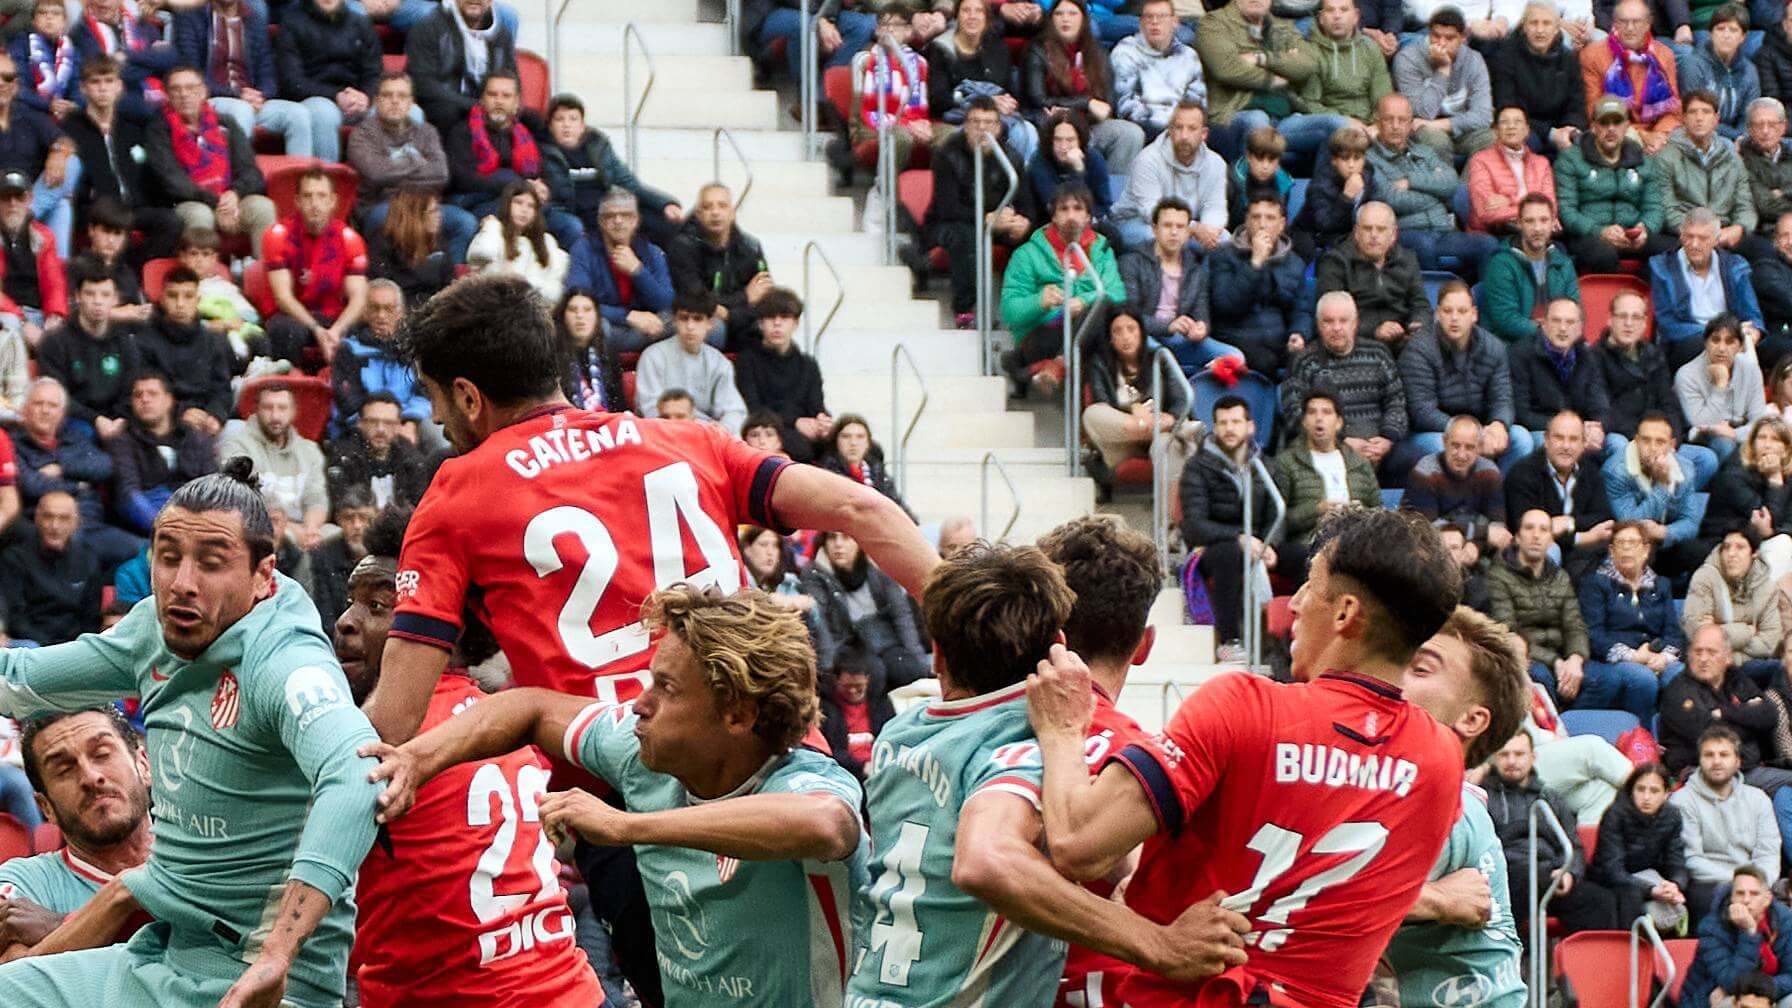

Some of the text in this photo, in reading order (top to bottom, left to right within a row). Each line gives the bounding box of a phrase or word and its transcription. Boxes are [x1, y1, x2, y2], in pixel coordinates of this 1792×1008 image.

[505, 416, 643, 479] CATENA
[523, 461, 741, 670] 24
[187, 814, 230, 840] AIR
[478, 903, 577, 967] DIG
[858, 822, 930, 987] 4
[717, 975, 755, 998] AIR
